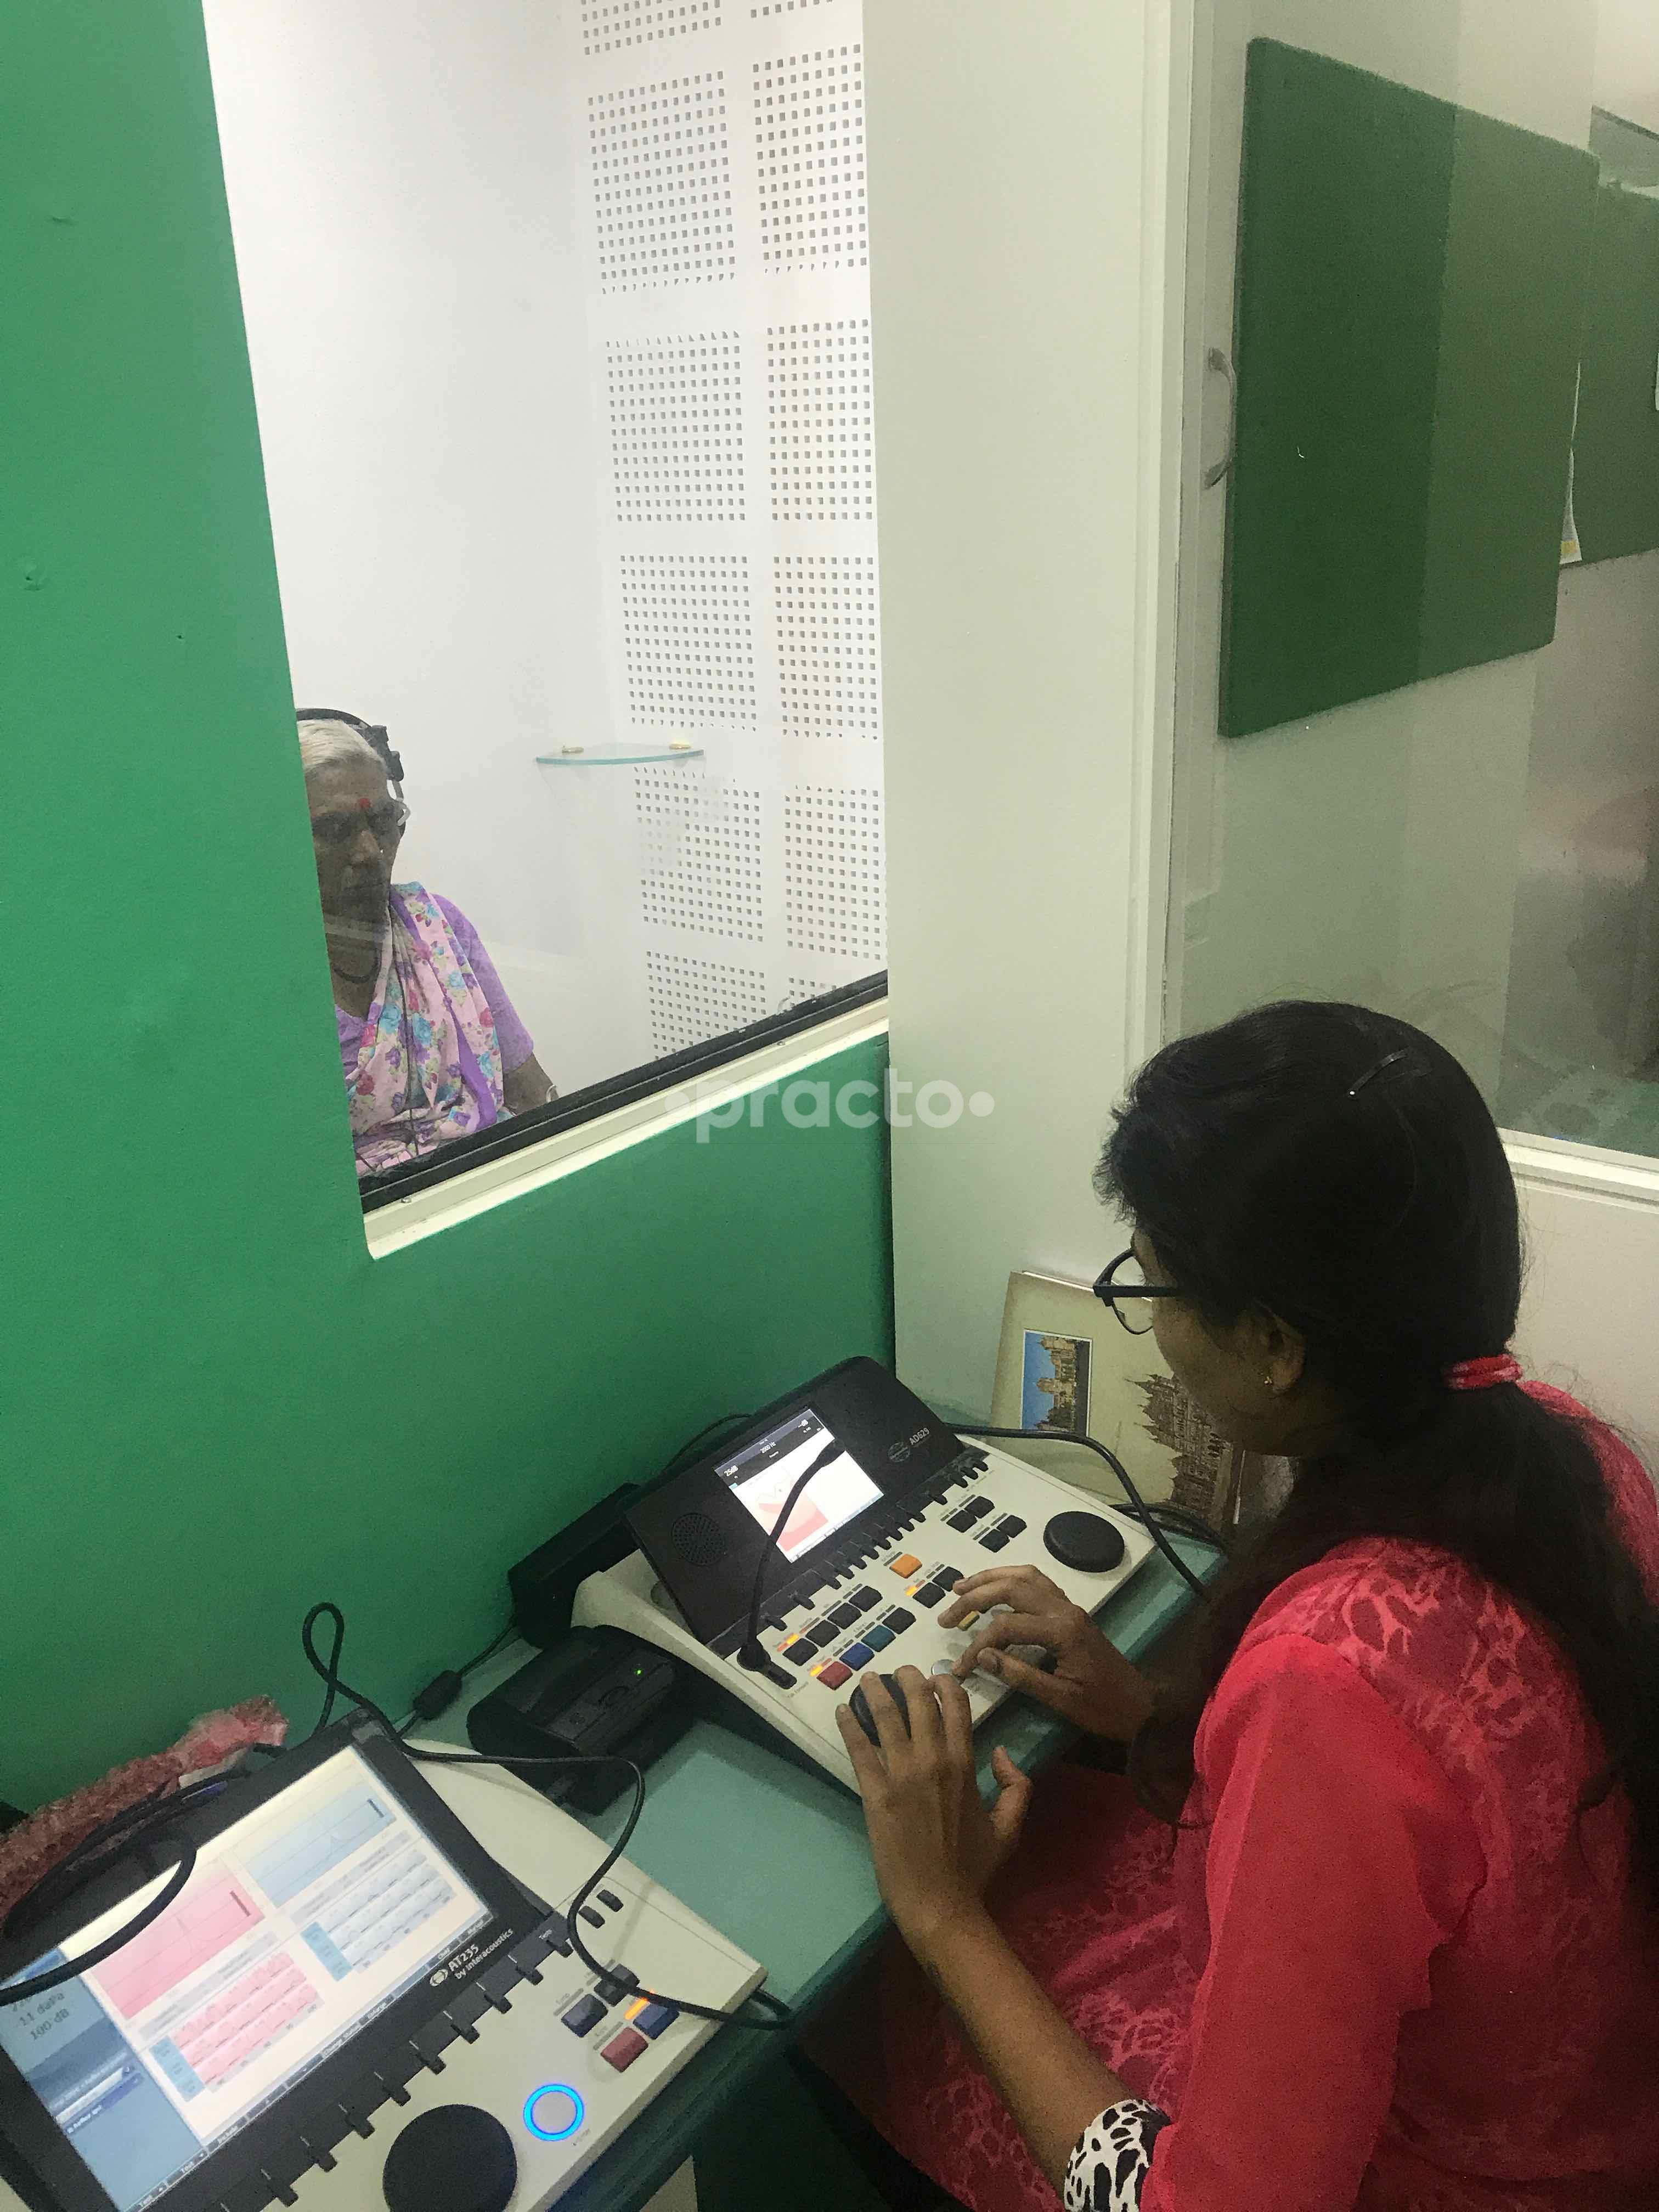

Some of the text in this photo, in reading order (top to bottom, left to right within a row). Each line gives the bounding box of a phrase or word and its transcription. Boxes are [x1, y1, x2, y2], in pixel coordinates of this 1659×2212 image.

[909, 1427, 930, 1446] AD629
[448, 1944, 479, 1972] AT235
[454, 1968, 466, 1979] by
[465, 1928, 514, 1971] interacoustics
[30, 2021, 52, 2040] 100
